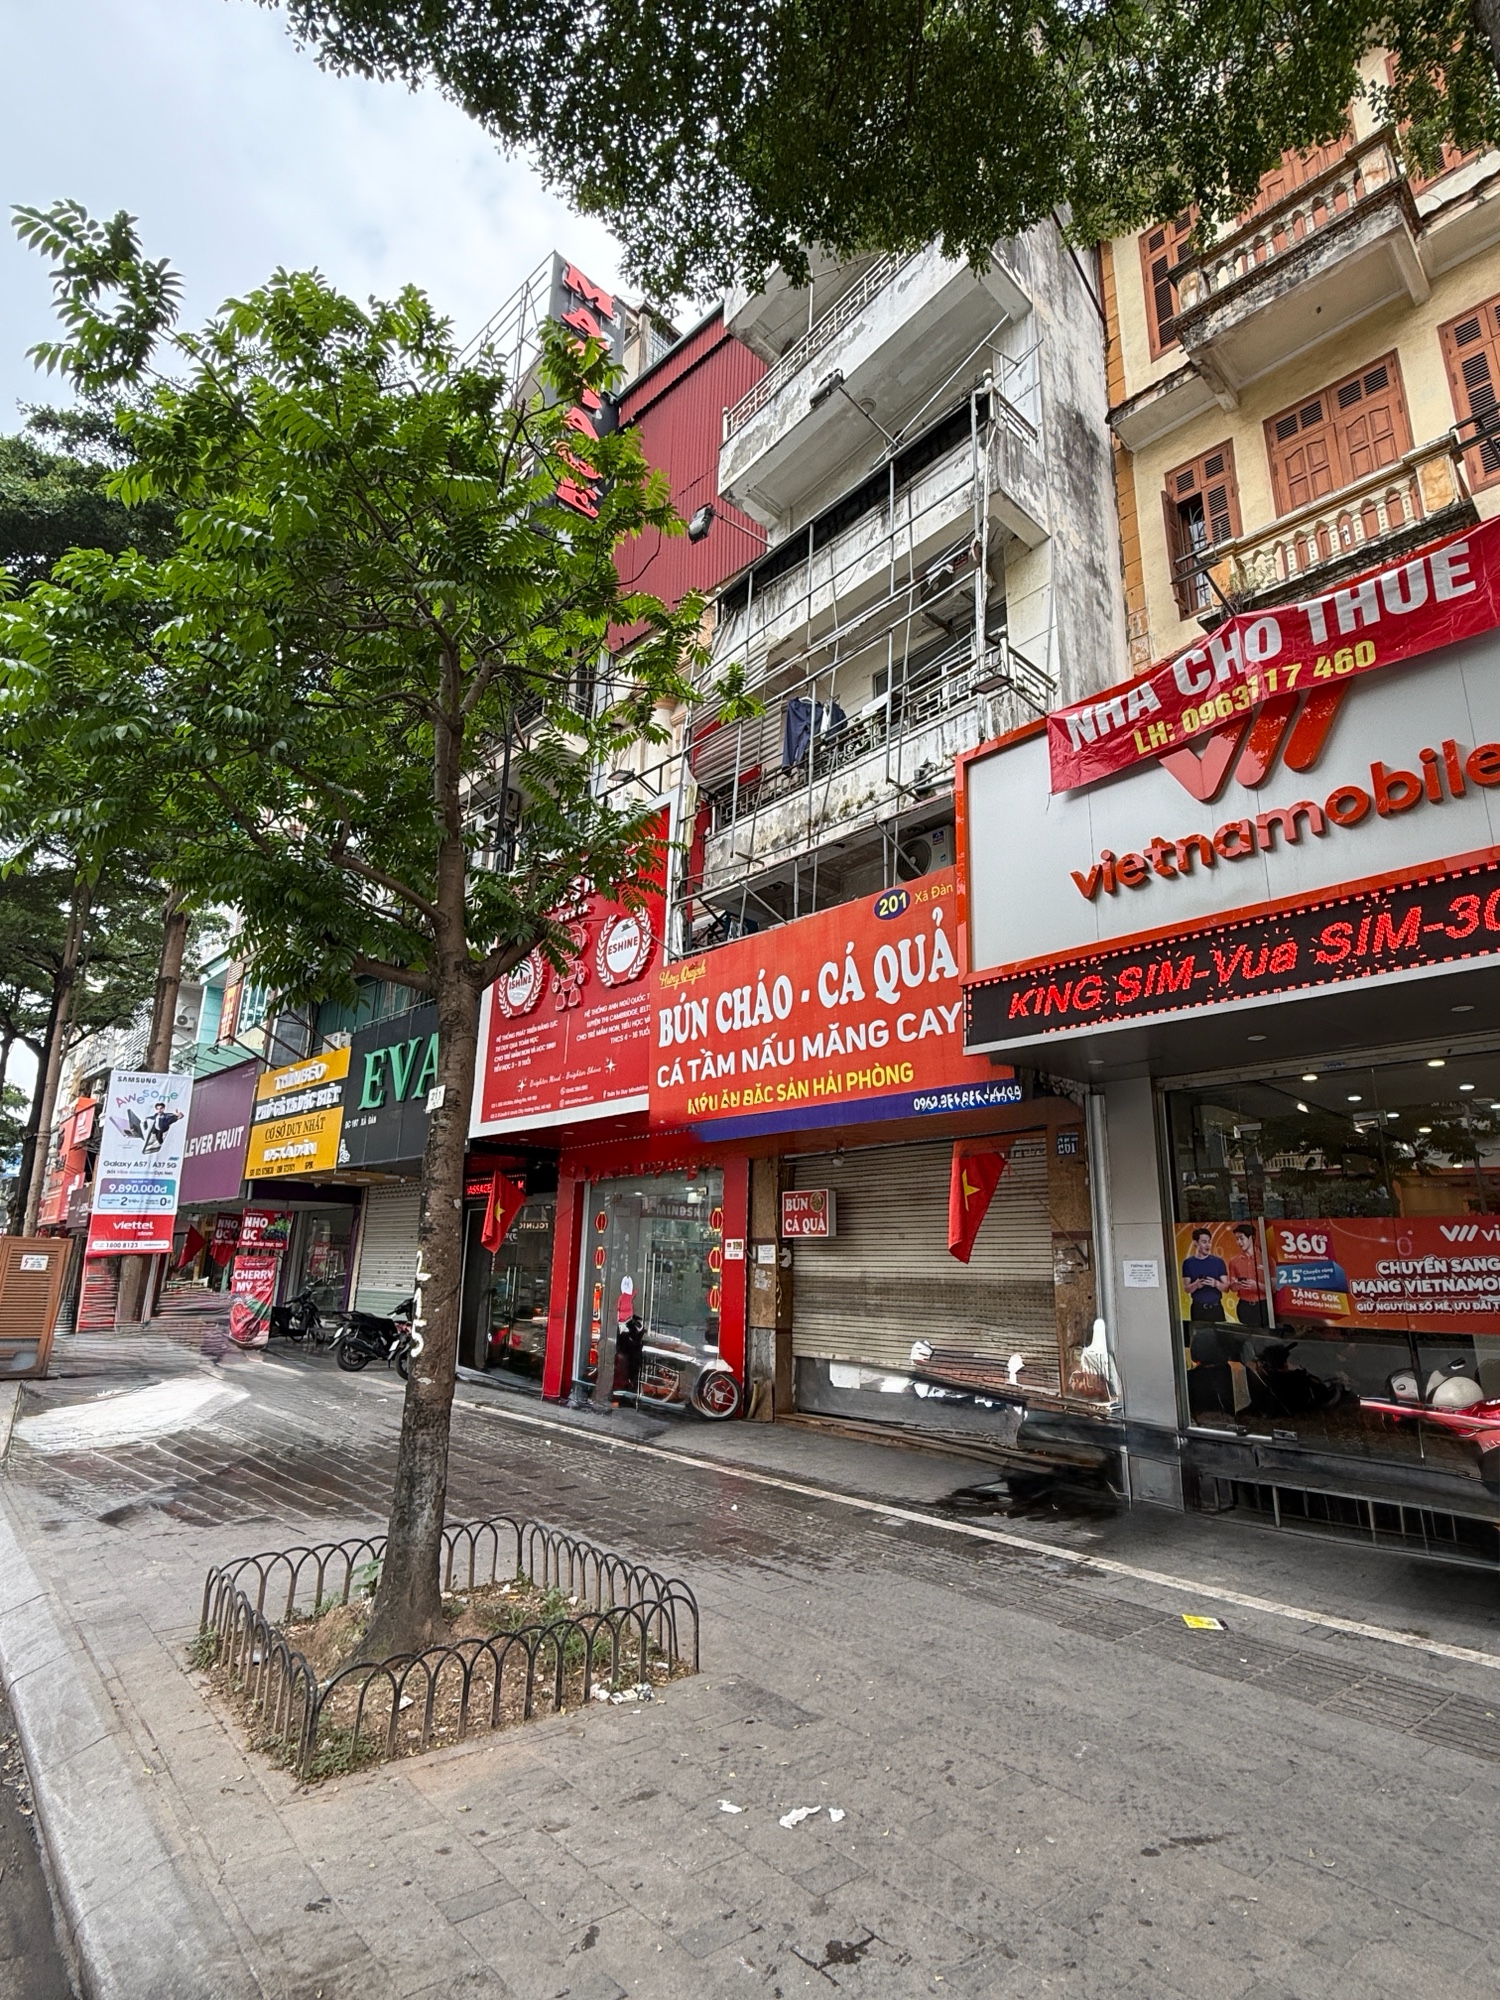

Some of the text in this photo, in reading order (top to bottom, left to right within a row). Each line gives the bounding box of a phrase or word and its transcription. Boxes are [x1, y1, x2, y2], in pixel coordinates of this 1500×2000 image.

[1173, 616, 1282, 696] CHO
[1133, 720, 1176, 754] LH:
[1313, 640, 1376, 679] 460
[1069, 738, 1500, 900] vietnamobile
[878, 883, 954, 917] 201 Xã Đàn
[658, 992, 709, 1048] BÚN
[715, 968, 793, 1034] CHÁO
[818, 941, 865, 1008] CÁ
[874, 906, 959, 1004] QUẢ
[1008, 974, 1102, 1020] KING
[657, 1001, 963, 1088] CÁ TẦM NẤU MĂNG CAY
[117, 1075, 157, 1084] SAMSUNG
[357, 1032, 439, 1111] EVA
[776, 1076, 809, 1101] SẢN
[813, 1069, 841, 1097] HẢI
[846, 1061, 914, 1091] PHÒNG
[115, 1089, 179, 1108] Awesome
[286, 1121, 303, 1137] DUY
[303, 1114, 326, 1133] NHẤT
[214, 1125, 245, 1152] FRUIT
[103, 1160, 132, 1168] Galaxy
[120, 1196, 127, 1206] 2
[785, 1194, 808, 1211] BÚN
[113, 1221, 154, 1230] viettel
[244, 1216, 268, 1228] NHO
[785, 1212, 826, 1234] CÁ QUẢ
[242, 1227, 258, 1240] ÚC
[1280, 1230, 1327, 1254] 360
[234, 1269, 274, 1280] CHERRY
[1451, 1256, 1500, 1273] SANG
[1322, 1293, 1340, 1302] 60K
[1352, 1279, 1401, 1297] MẠNG
[1357, 1301, 1375, 1312] GIỮ
[1420, 1299, 1433, 1311] SỐ
